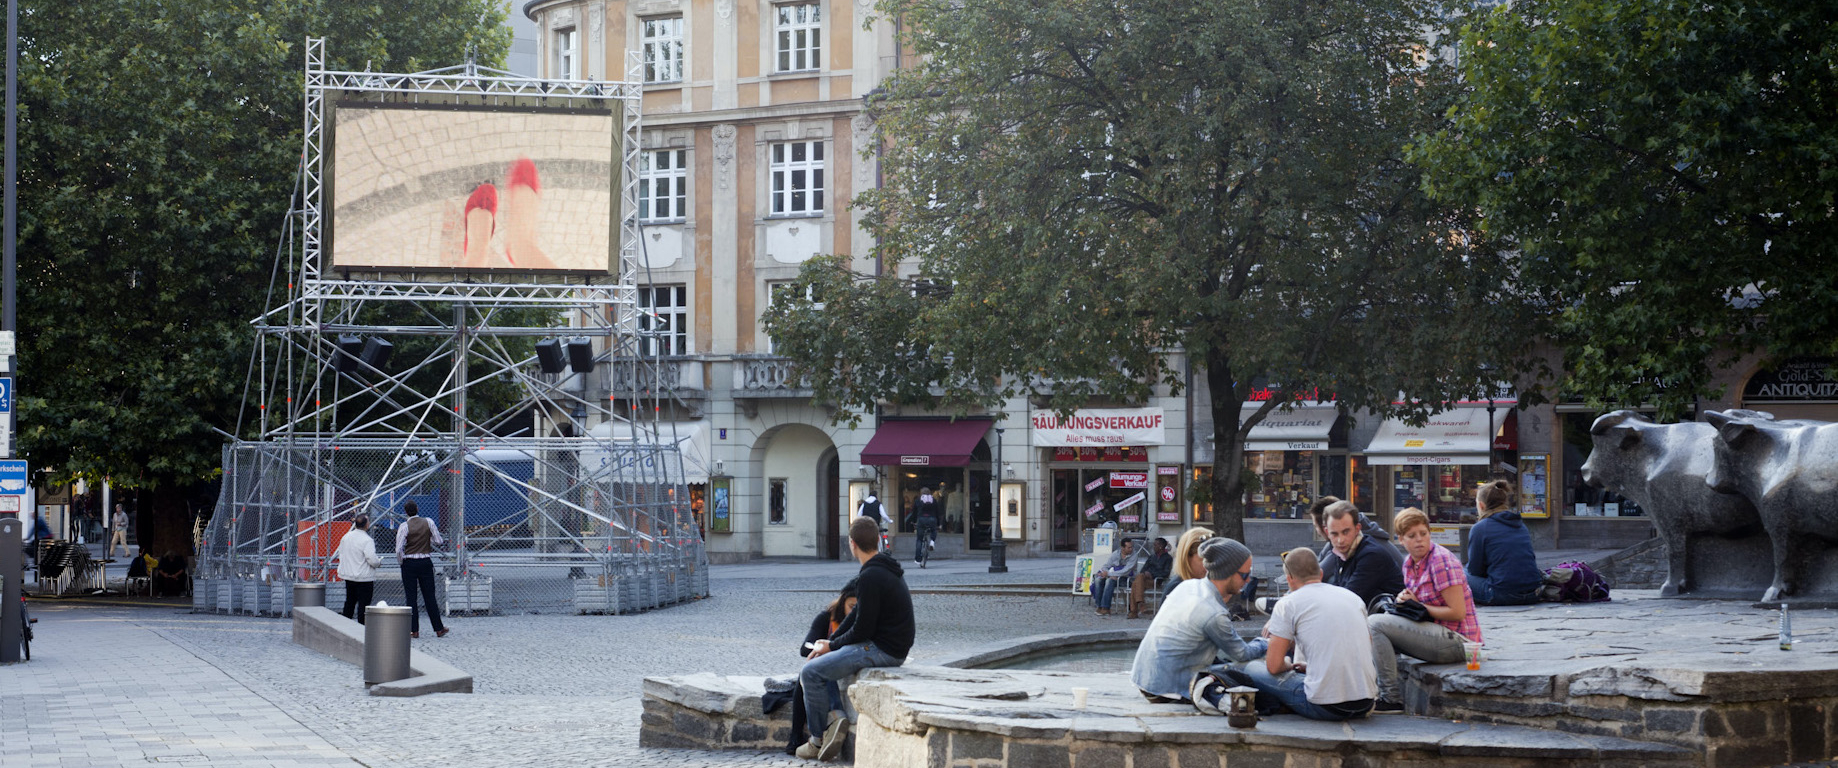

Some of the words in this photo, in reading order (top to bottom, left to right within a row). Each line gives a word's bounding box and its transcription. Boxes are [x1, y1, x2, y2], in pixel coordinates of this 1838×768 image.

[1066, 434, 1083, 443] Alles
[1085, 435, 1105, 443] muss
[1107, 434, 1125, 443] raus!
[1406, 455, 1451, 463] Import-Cigars
[1110, 473, 1145, 481] Räumungs-
